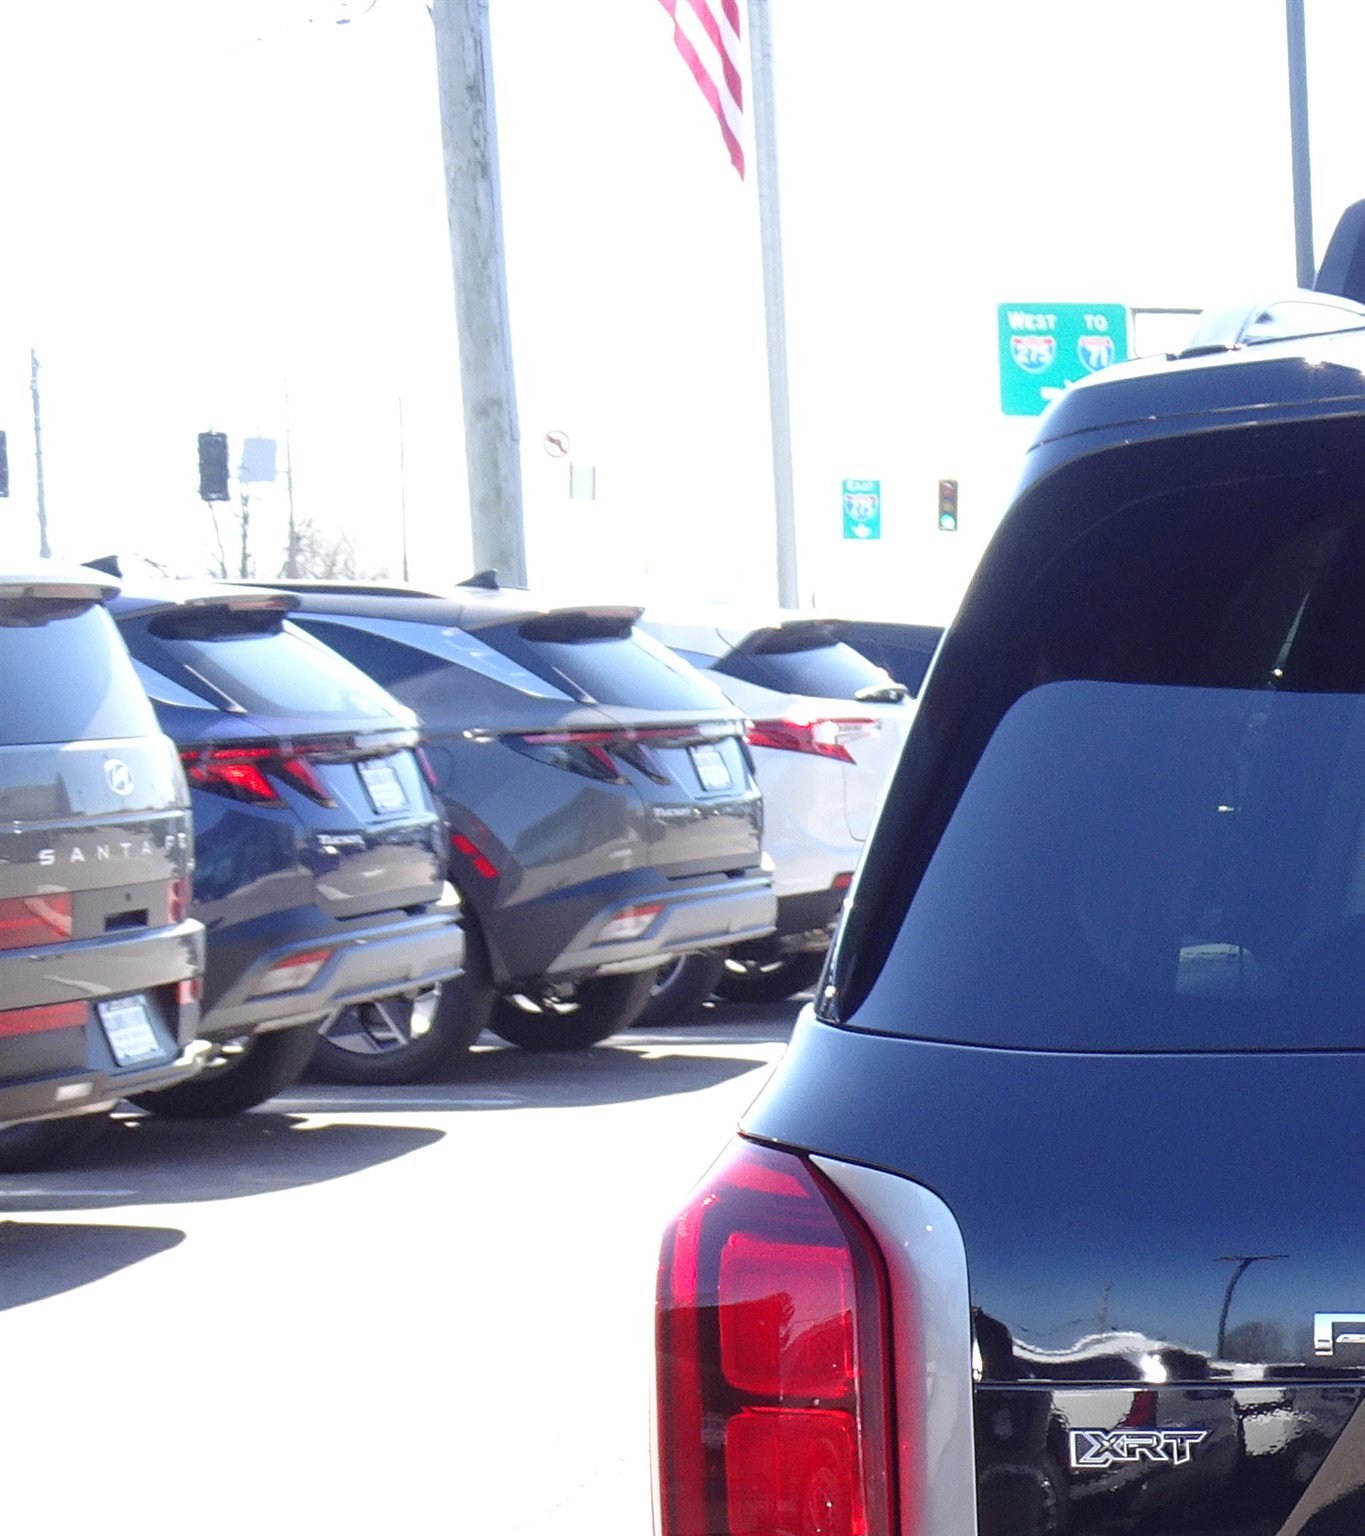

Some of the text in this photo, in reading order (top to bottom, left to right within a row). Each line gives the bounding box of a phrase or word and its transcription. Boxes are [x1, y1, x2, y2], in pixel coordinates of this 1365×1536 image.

[1007, 311, 1109, 331] WEST TO
[1016, 343, 1108, 367] 275 71
[38, 841, 152, 866] SANTA
[1070, 1430, 1208, 1468] XRT
